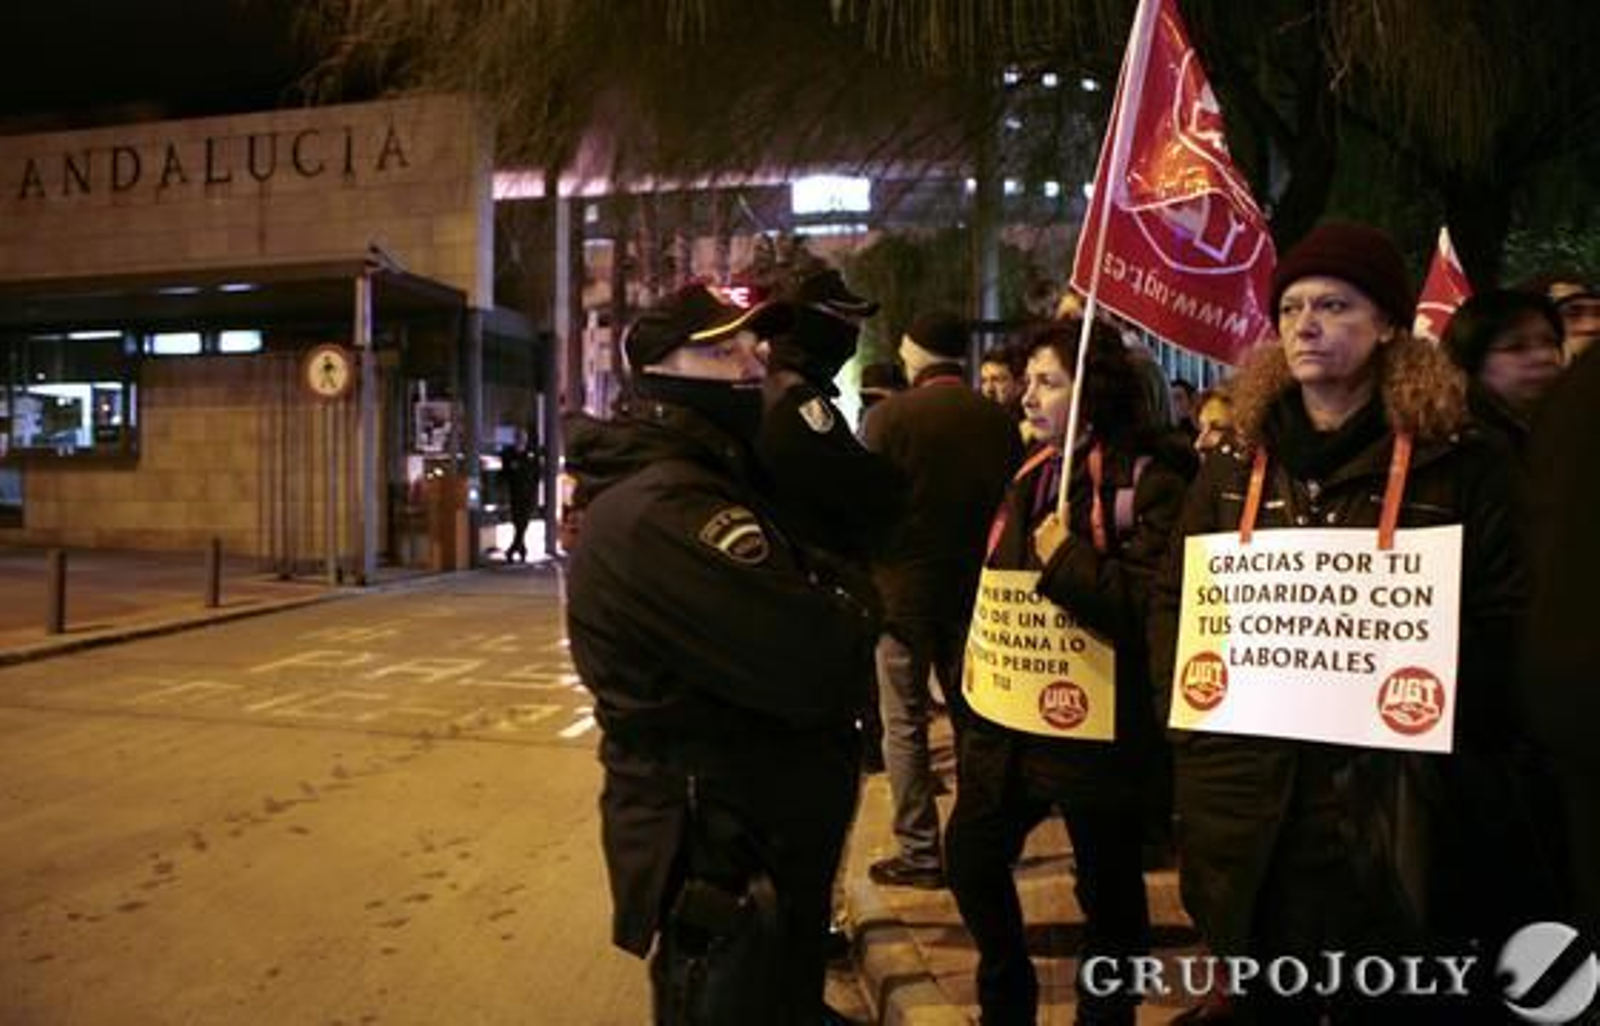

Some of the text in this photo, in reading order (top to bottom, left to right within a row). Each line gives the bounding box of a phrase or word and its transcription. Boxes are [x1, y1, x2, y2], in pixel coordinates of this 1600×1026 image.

[19, 121, 409, 199] ANDALUCIA
[1209, 552, 1421, 575] GRACIAS POR TU
[1197, 584, 1433, 608] SOLIDARIDAD CON
[1018, 612, 1046, 629] UN
[1198, 613, 1430, 642] TUS COMPAÑEROS
[1060, 637, 1086, 653] LO
[1002, 656, 1069, 676] PERDER
[1230, 646, 1377, 675] LABORALES
[1187, 661, 1223, 685] UGT
[1044, 688, 1082, 709] UGT
[1384, 677, 1438, 703] UGT
